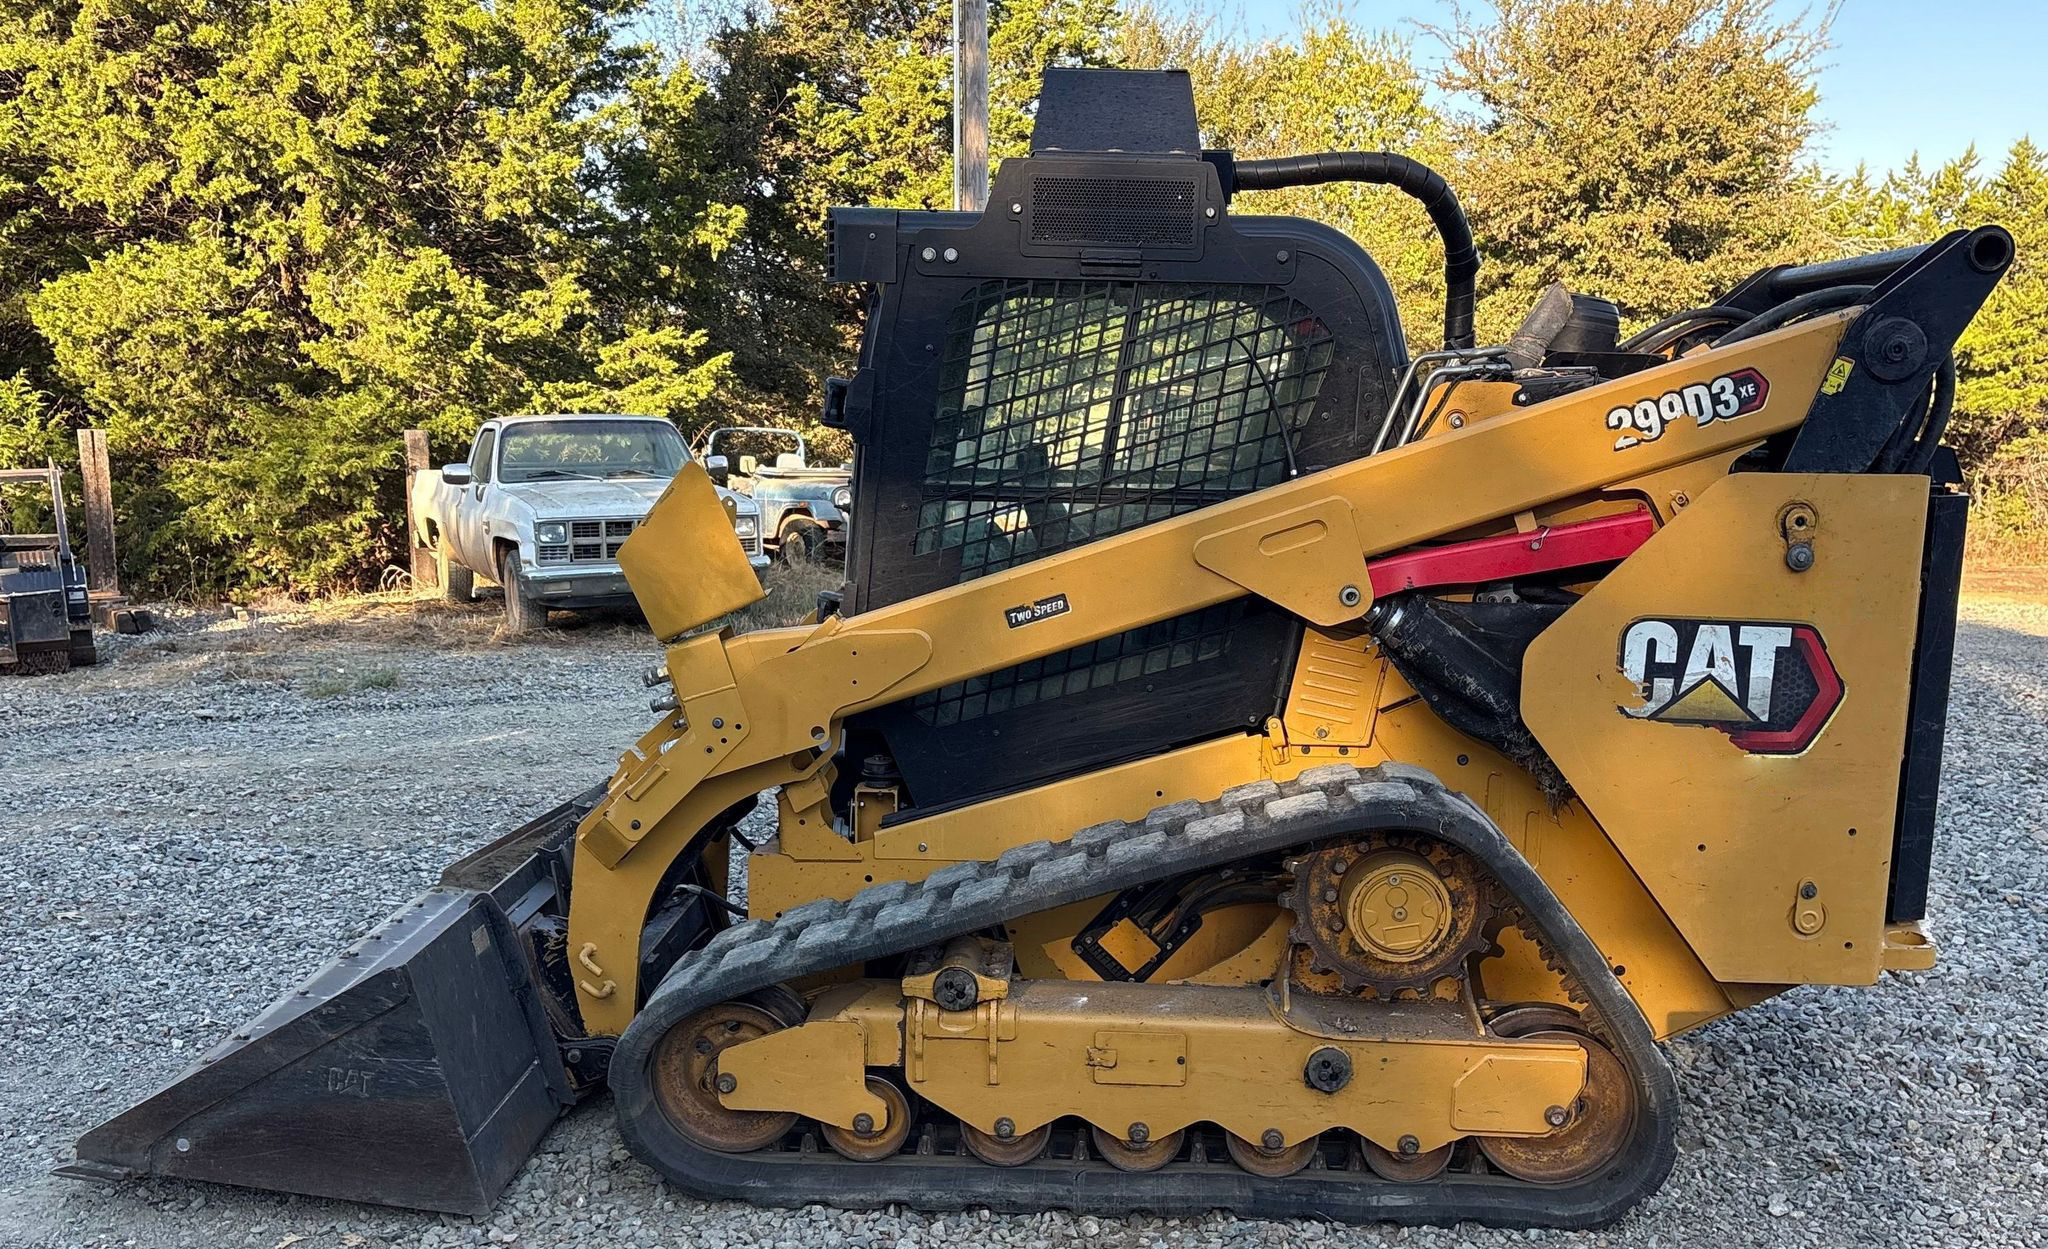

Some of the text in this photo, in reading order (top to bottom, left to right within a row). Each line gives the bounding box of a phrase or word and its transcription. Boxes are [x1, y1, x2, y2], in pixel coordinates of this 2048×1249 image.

[1738, 383, 1757, 399] XE
[1009, 600, 1064, 624] TWO SPEED
[1623, 620, 1793, 723] CAT
[327, 1067, 376, 1096] CAT
